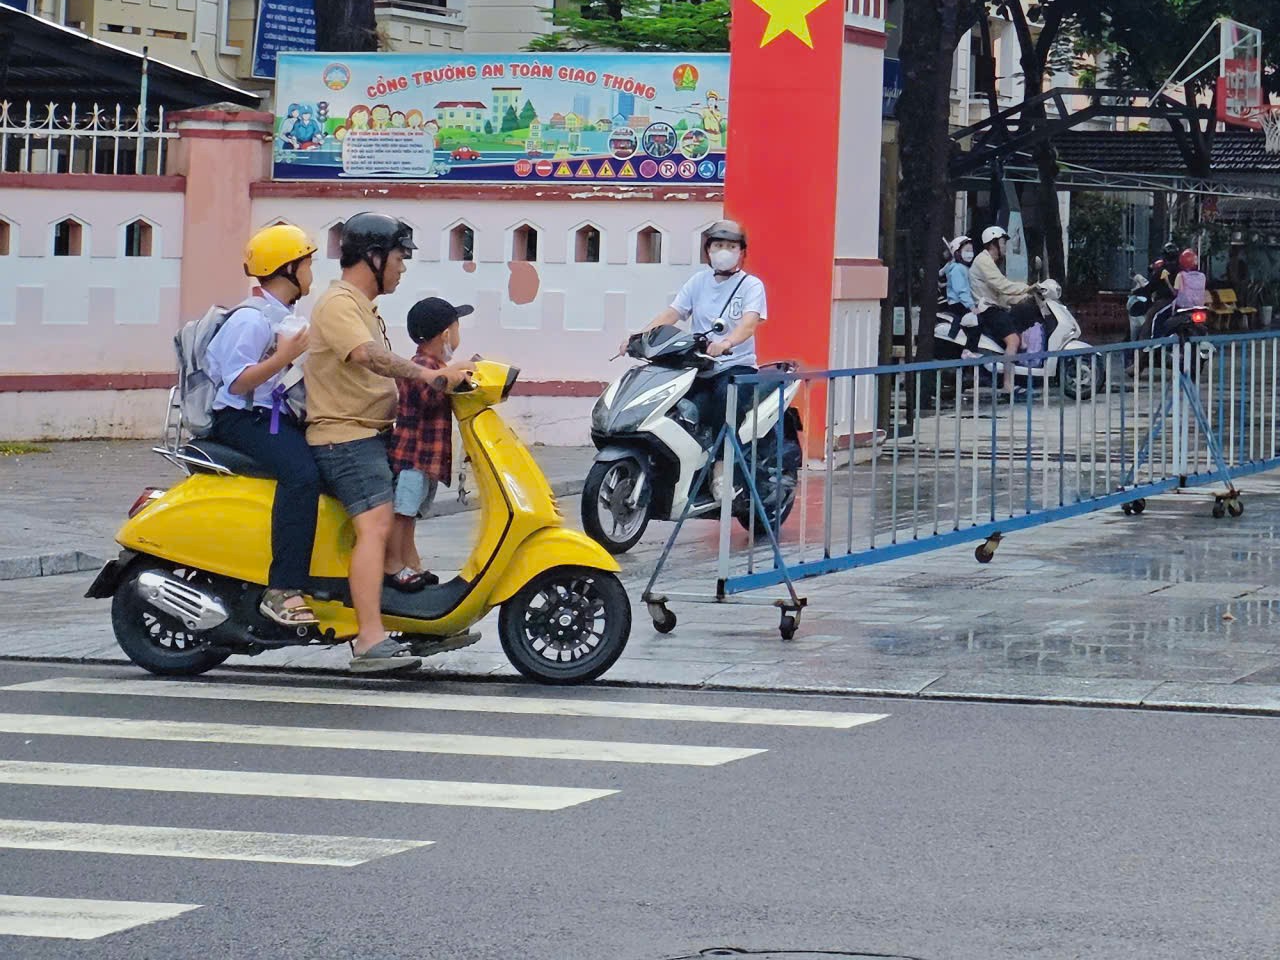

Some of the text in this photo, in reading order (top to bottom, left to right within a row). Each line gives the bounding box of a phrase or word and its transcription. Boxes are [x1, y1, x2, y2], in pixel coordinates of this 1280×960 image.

[411, 63, 477, 86] TRƯỜNG
[481, 63, 505, 78] AN
[509, 61, 554, 79] TOÀN
[558, 68, 597, 84] GIAO
[601, 73, 657, 100] THÔNG
